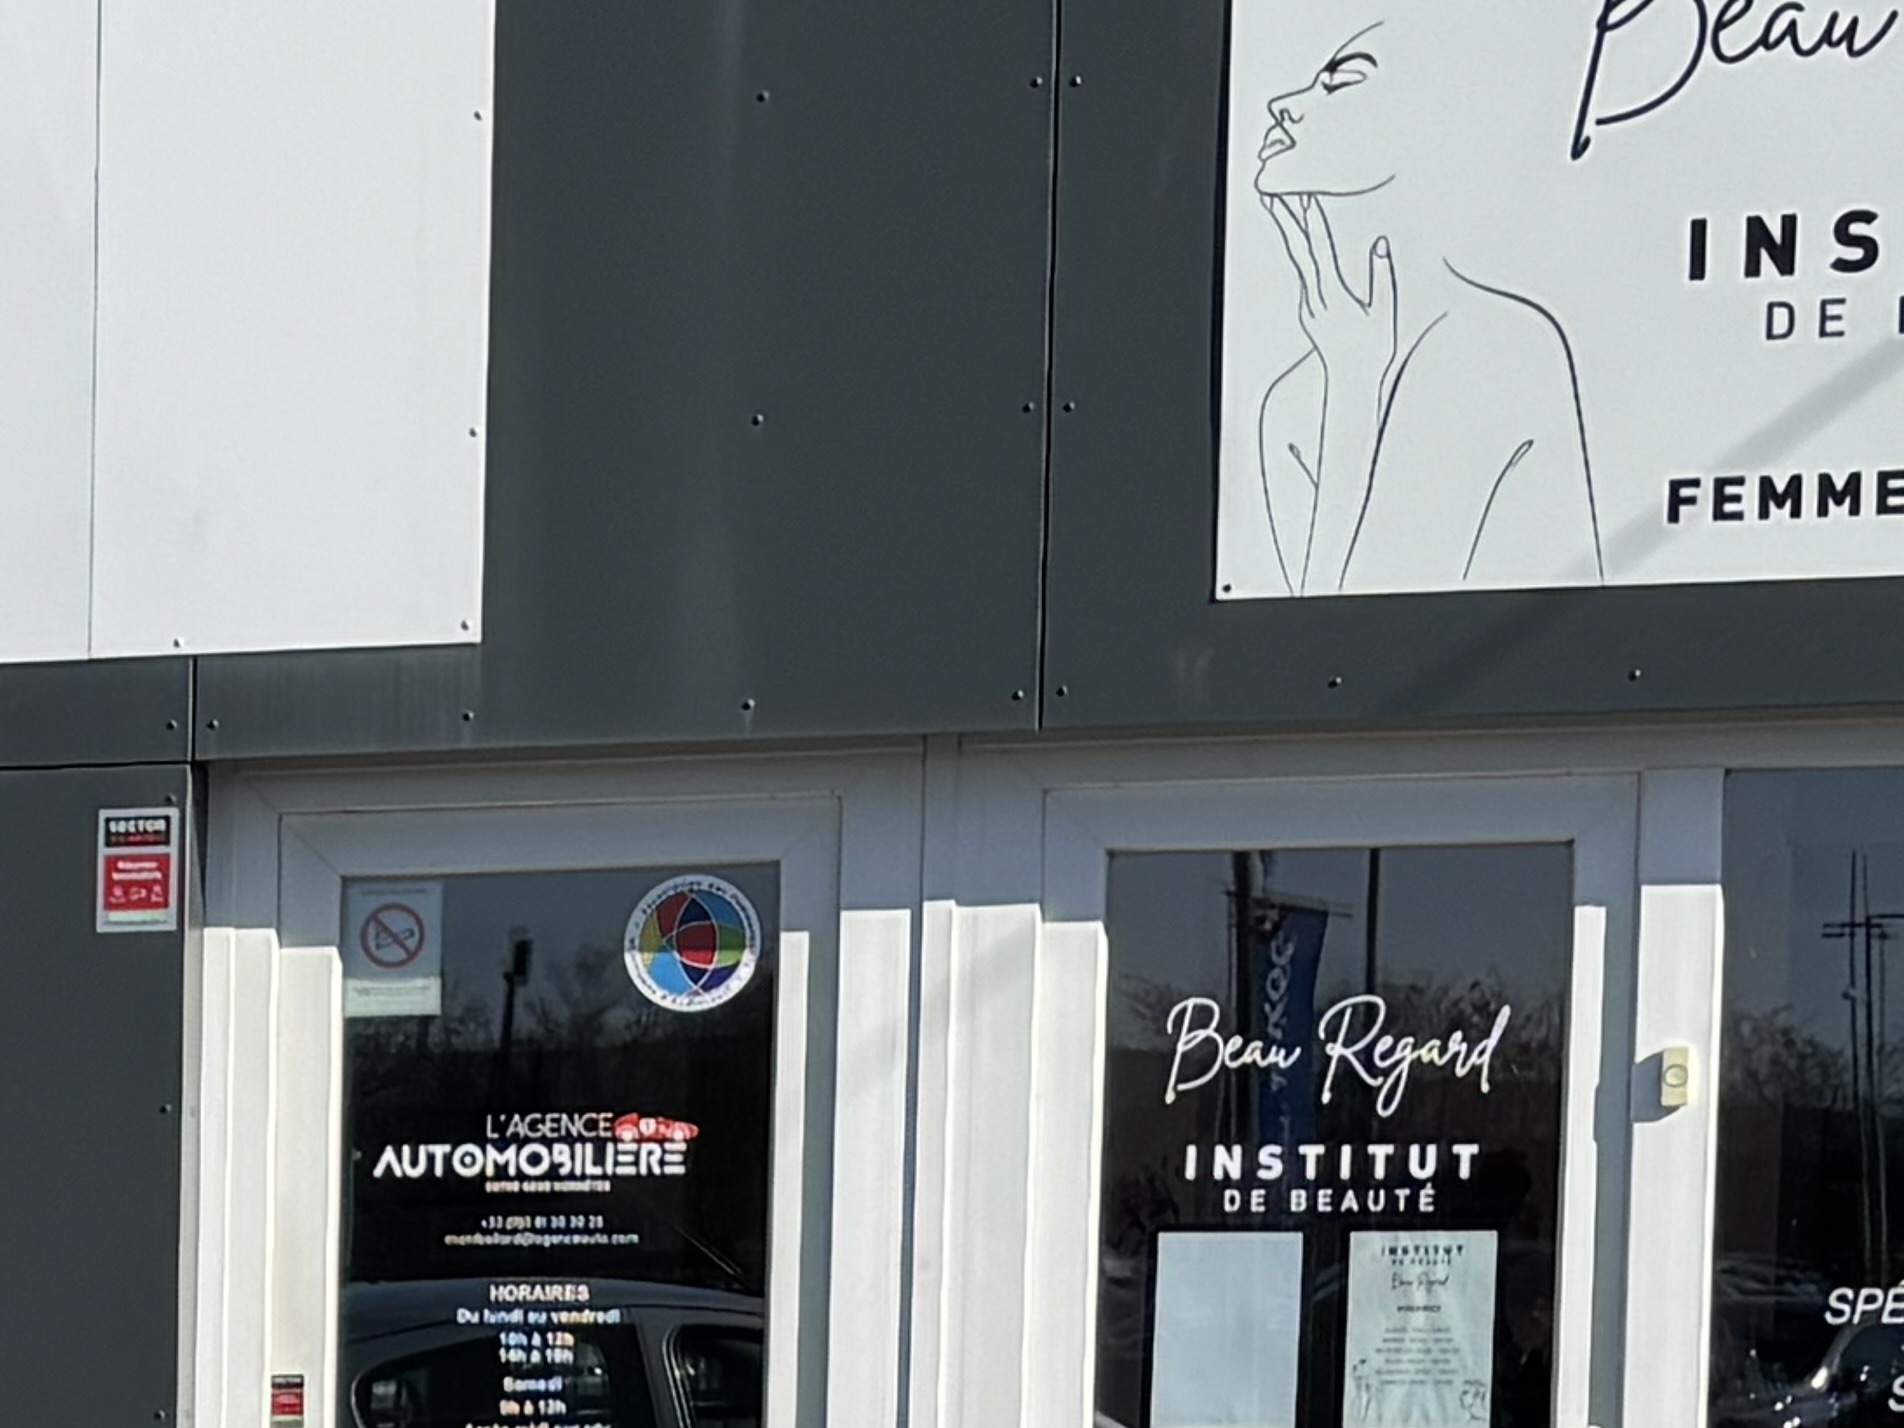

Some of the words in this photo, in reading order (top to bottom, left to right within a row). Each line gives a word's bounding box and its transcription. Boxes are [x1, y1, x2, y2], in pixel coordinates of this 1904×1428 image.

[1766, 298, 1847, 341] DE
[1165, 997, 1302, 1104] Beau
[1318, 993, 1512, 1118] Regard
[486, 1113, 613, 1139] L'AGENCE
[1184, 1143, 1480, 1181] INSTITUT
[1223, 1188, 1267, 1213] DE
[1289, 1181, 1436, 1213] BEAUTÉ
[489, 1283, 590, 1302] HORAIRES
[456, 1307, 480, 1324] Du
[550, 1307, 622, 1324] vendredi
[503, 1376, 563, 1394] Samedi
